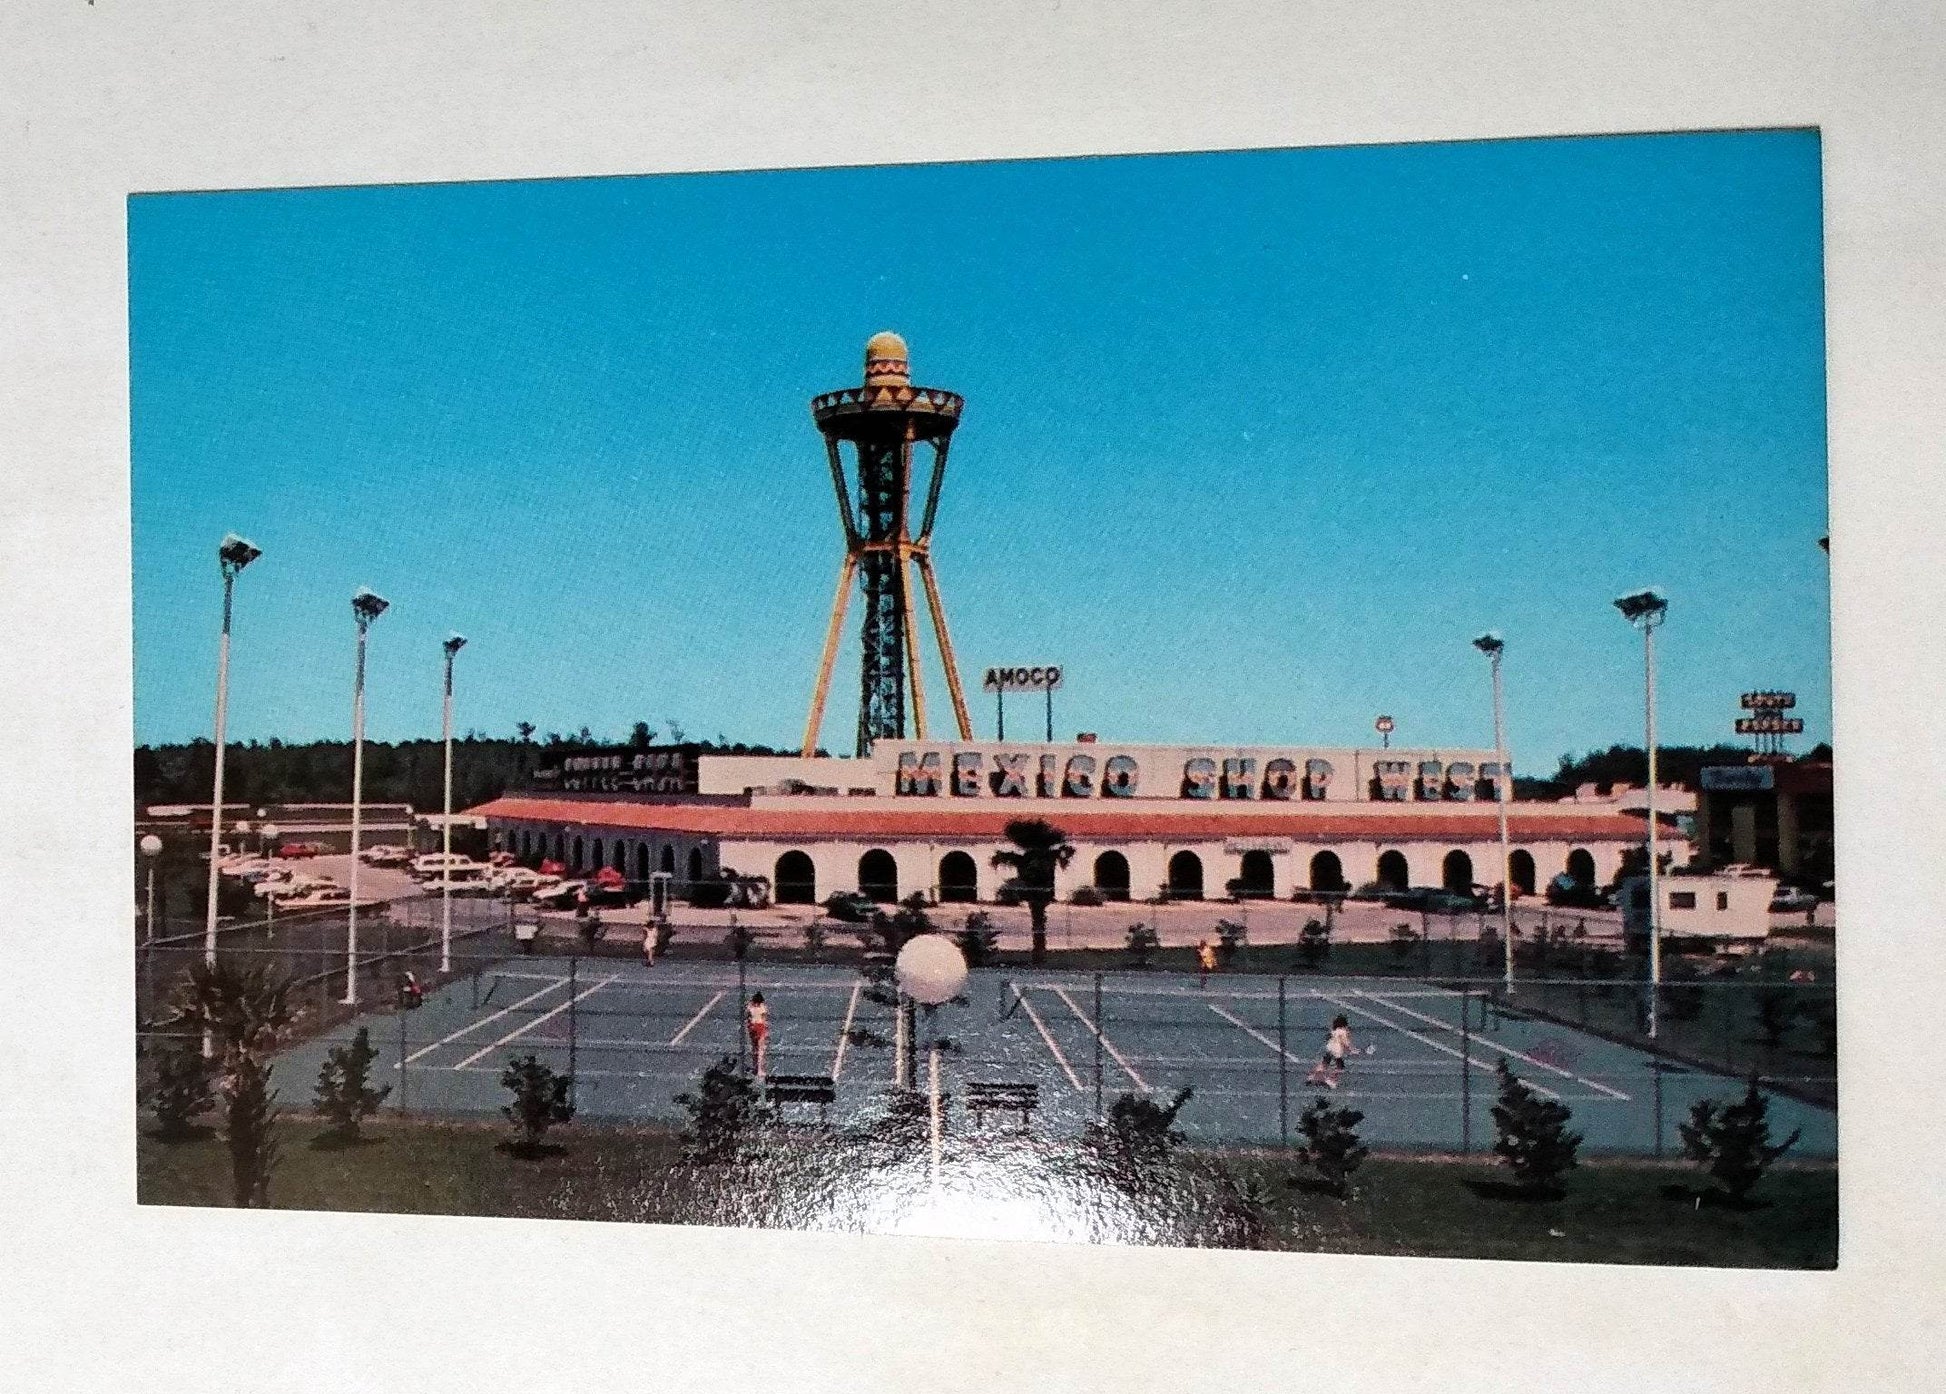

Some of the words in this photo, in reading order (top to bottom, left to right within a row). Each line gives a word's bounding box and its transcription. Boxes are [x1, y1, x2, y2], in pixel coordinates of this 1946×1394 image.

[984, 666, 1061, 687] AMOCO
[896, 751, 1138, 797] MEXICO
[1181, 757, 1333, 800] SHOP
[1370, 760, 1512, 801] WEST
